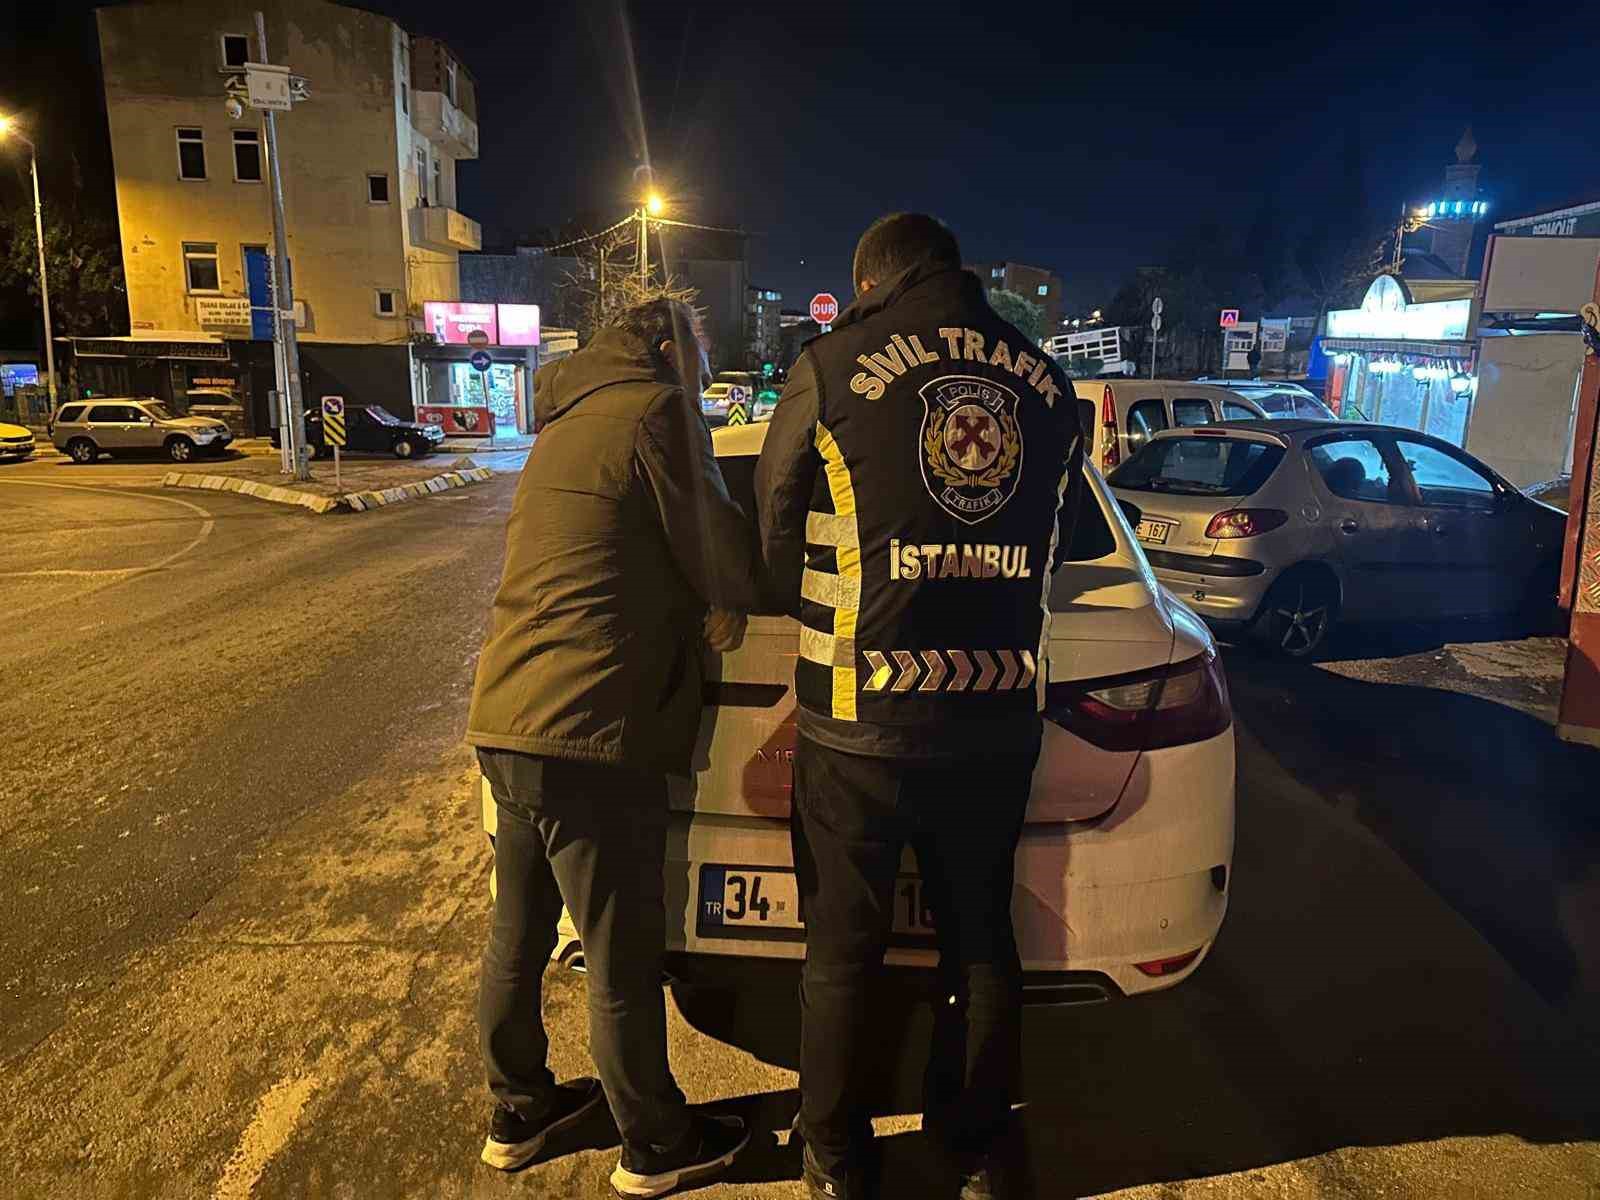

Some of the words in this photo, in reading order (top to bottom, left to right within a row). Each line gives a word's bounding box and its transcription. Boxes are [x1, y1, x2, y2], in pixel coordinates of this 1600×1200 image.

[813, 303, 836, 315] DUR
[850, 333, 940, 401] SİVİL
[939, 327, 1062, 409] TRAFIK
[1148, 522, 1166, 538] 167
[890, 538, 1031, 580] İSTANBUL
[705, 901, 722, 916] TR
[726, 876, 770, 921] 34
